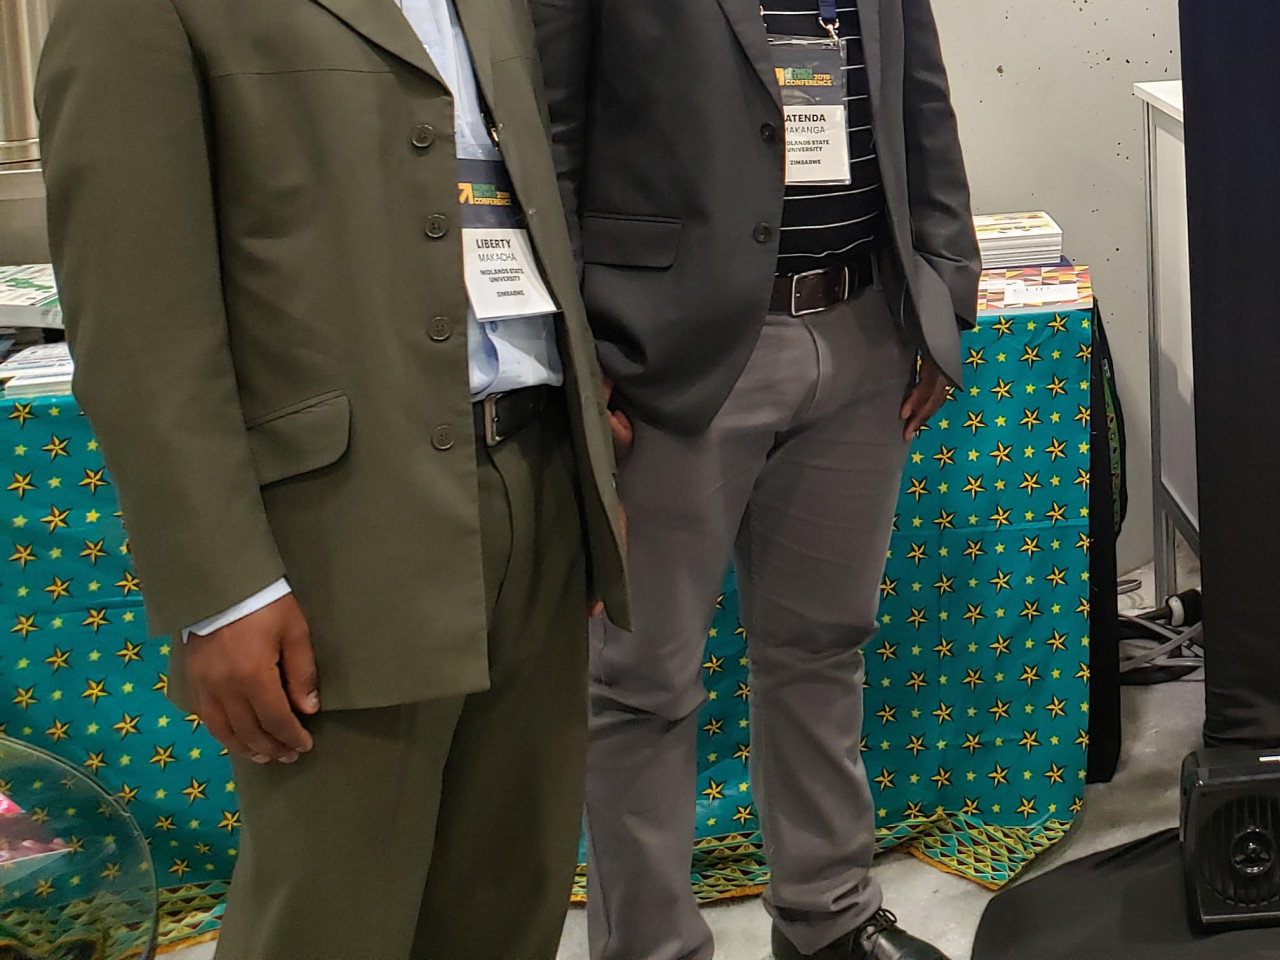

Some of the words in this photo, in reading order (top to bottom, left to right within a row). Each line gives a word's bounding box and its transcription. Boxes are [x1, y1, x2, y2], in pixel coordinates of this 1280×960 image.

[785, 114, 826, 123] ATENDA
[475, 239, 512, 249] LIBERTY
[478, 252, 518, 262] MAKACHA
[480, 268, 509, 276] MIDLANDS
[488, 275, 521, 283] UNIVERSITY
